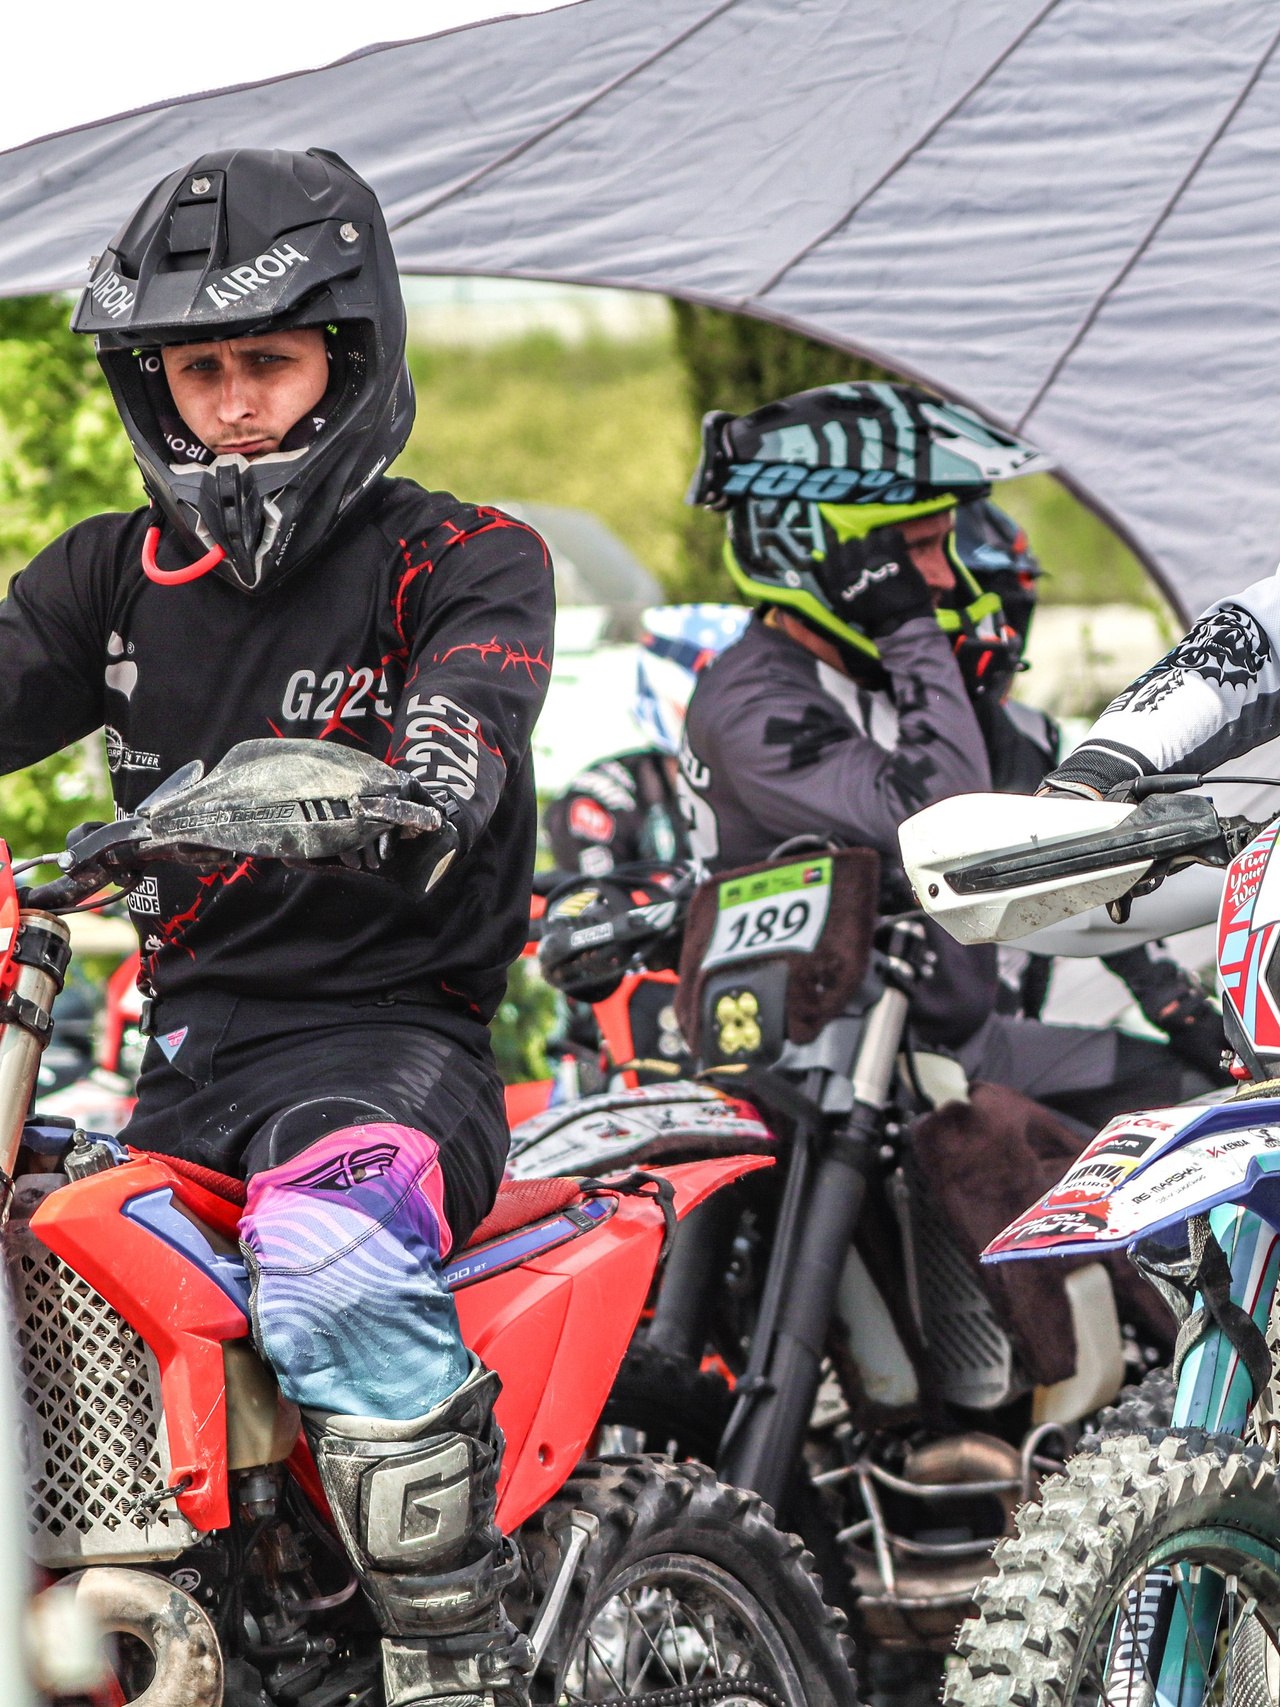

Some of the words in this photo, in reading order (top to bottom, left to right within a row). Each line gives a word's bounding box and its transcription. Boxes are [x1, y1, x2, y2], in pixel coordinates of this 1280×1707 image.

[723, 462, 917, 503] 100%
[134, 754, 160, 768] TVER
[129, 897, 161, 915] GLIDE
[726, 898, 811, 952] 189
[1220, 1139, 1251, 1152] KENDA
[443, 1267, 470, 1285] 00
[367, 1441, 471, 1559] G
